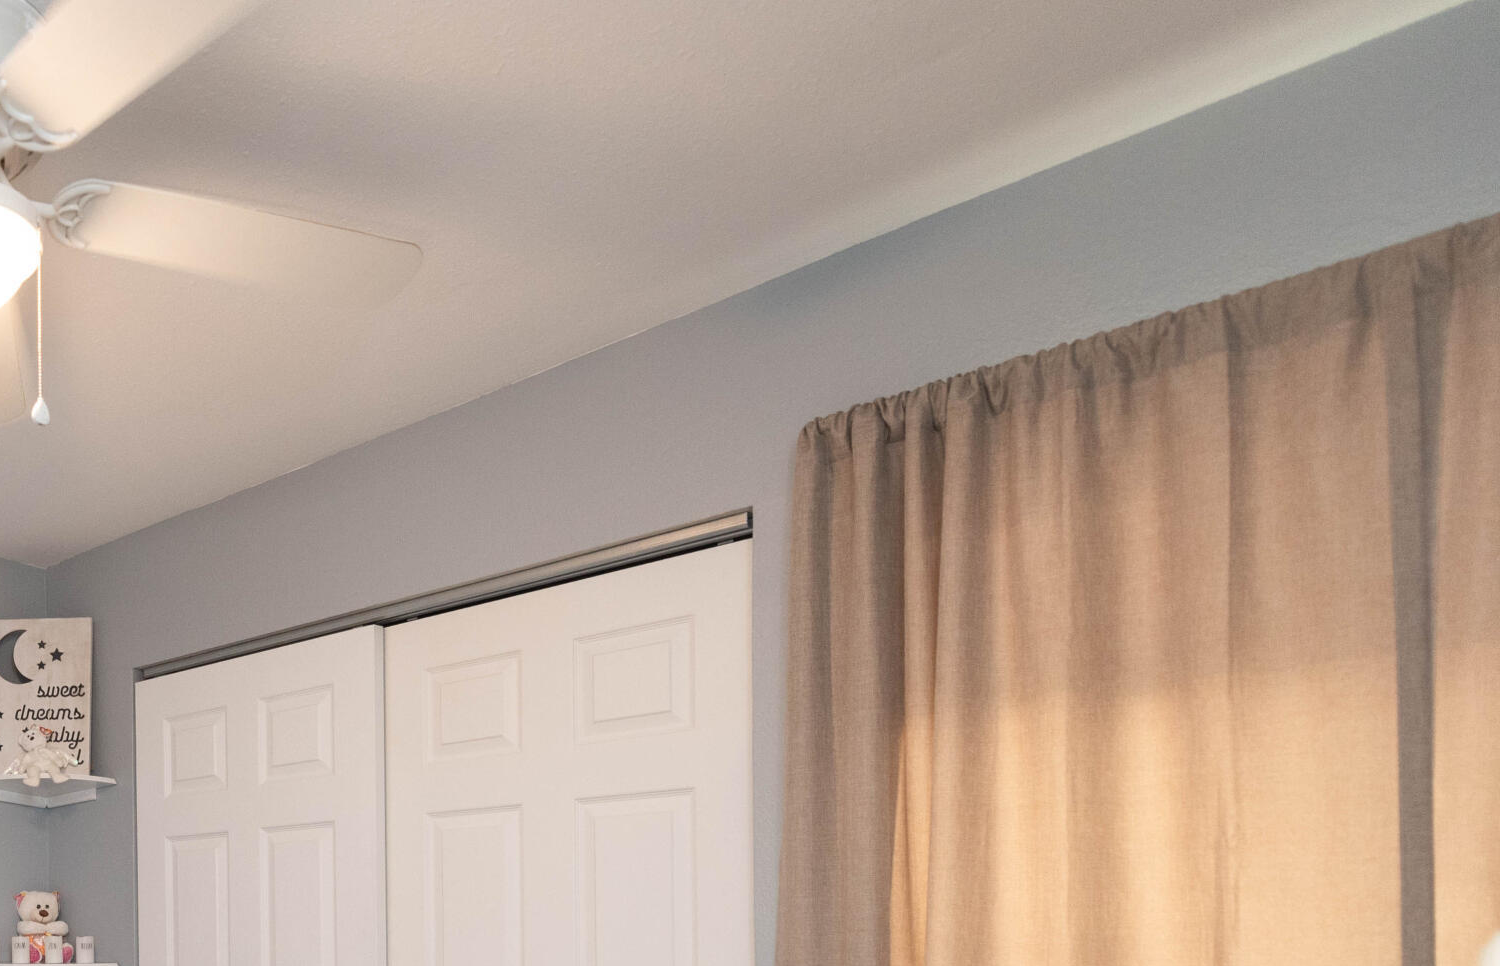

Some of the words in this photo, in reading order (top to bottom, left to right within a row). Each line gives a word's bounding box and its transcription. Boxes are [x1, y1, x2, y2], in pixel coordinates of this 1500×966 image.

[37, 683, 85, 698] sweet
[14, 705, 85, 721] dreams
[46, 726, 85, 750] aby
